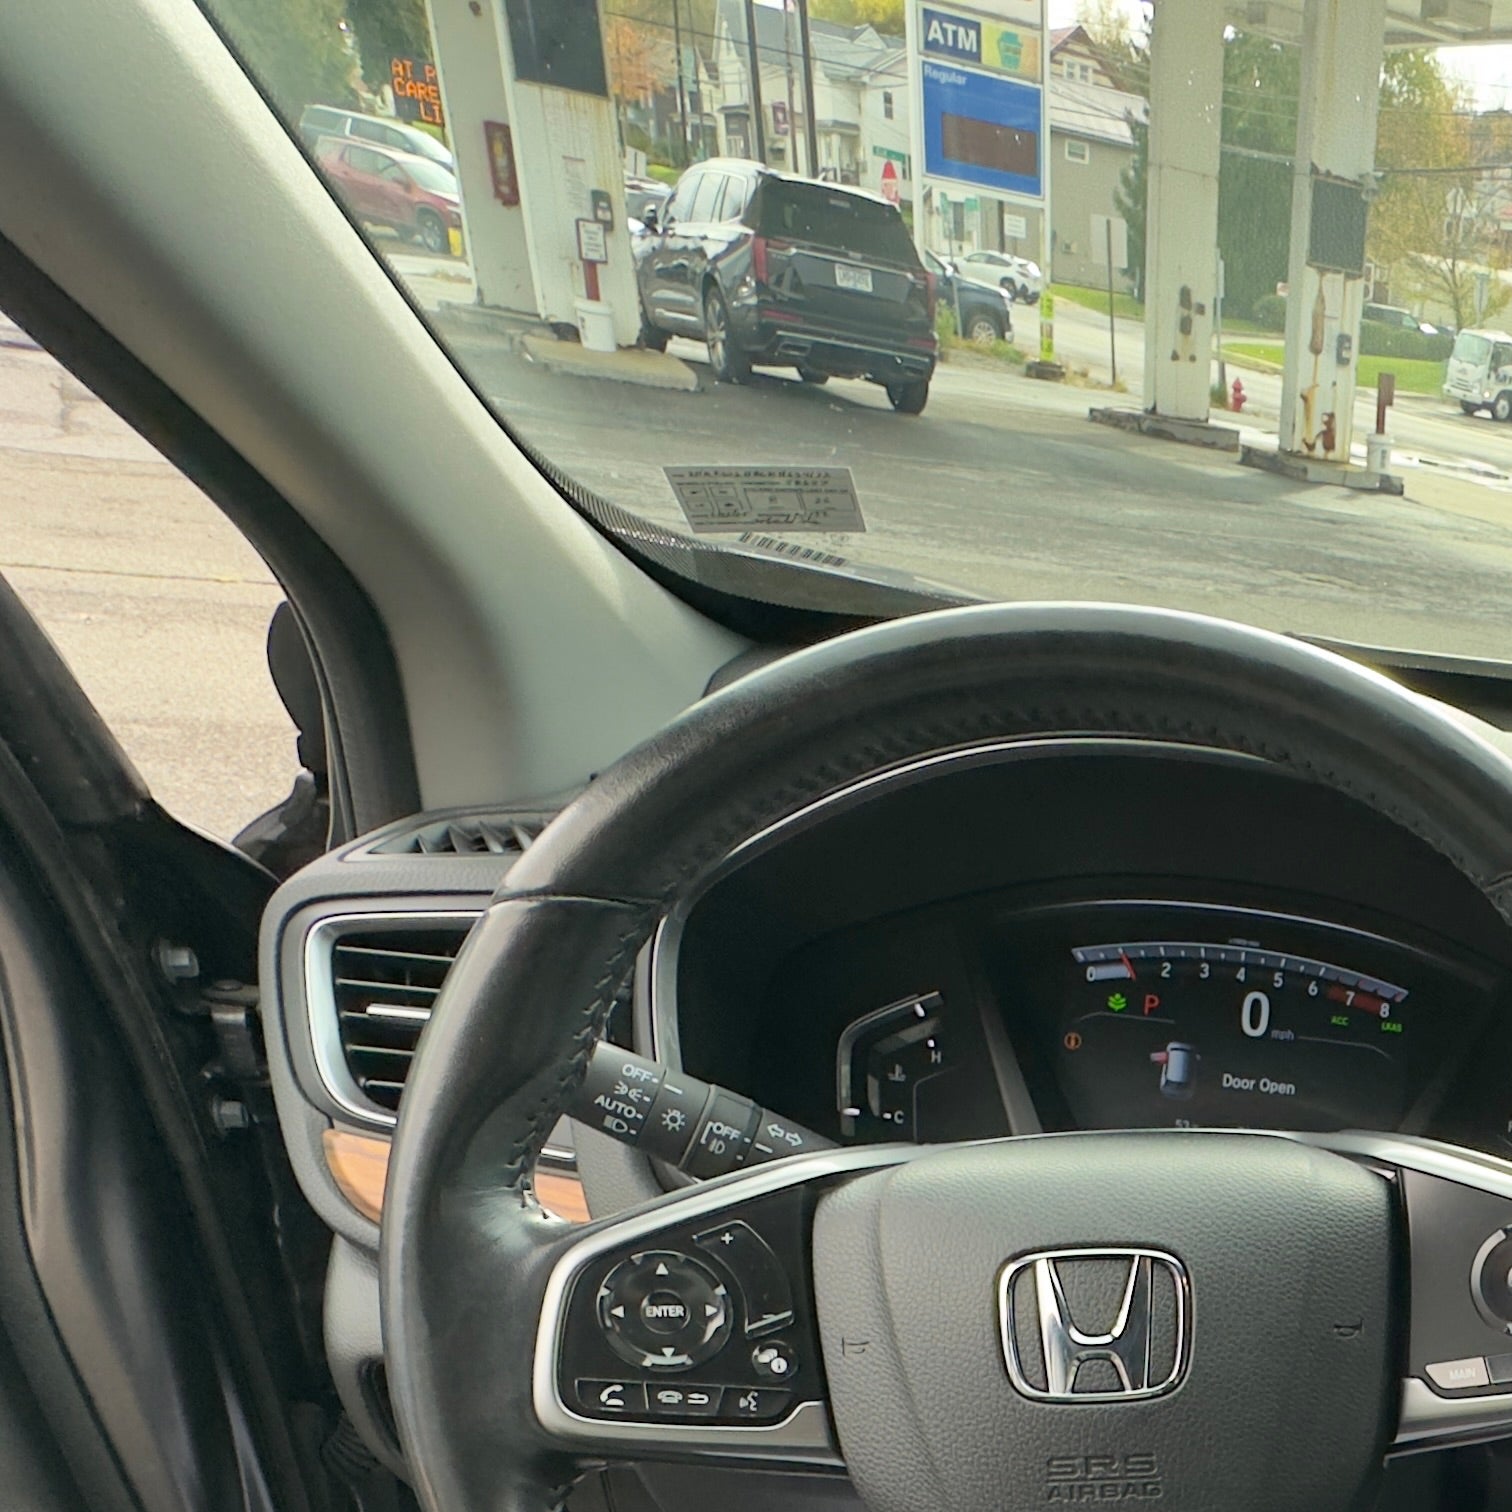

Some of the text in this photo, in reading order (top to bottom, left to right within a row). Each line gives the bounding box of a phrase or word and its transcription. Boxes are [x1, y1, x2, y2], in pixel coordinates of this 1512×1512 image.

[927, 19, 977, 53] ATM
[392, 57, 412, 79] AT
[924, 65, 967, 86] Regular
[393, 76, 440, 103] CARE
[1085, 961, 1390, 1018] 0 2 3 4 5 6 7 8
[1143, 994, 1160, 1016] P
[1240, 991, 1294, 1042] 0 mph
[1331, 1015, 1350, 1027] ACC
[931, 1051, 942, 1063] H
[621, 1063, 653, 1083] OFF
[1222, 1073, 1296, 1096] Door Open
[594, 1095, 637, 1119] AUTO
[893, 1110, 905, 1124] C
[711, 1122, 742, 1141] OFF
[645, 1305, 685, 1318] ENTER
[1450, 1368, 1476, 1380] MAIN
[1046, 1455, 1158, 1481] SRS
[1046, 1482, 1164, 1502] AIRBAG
